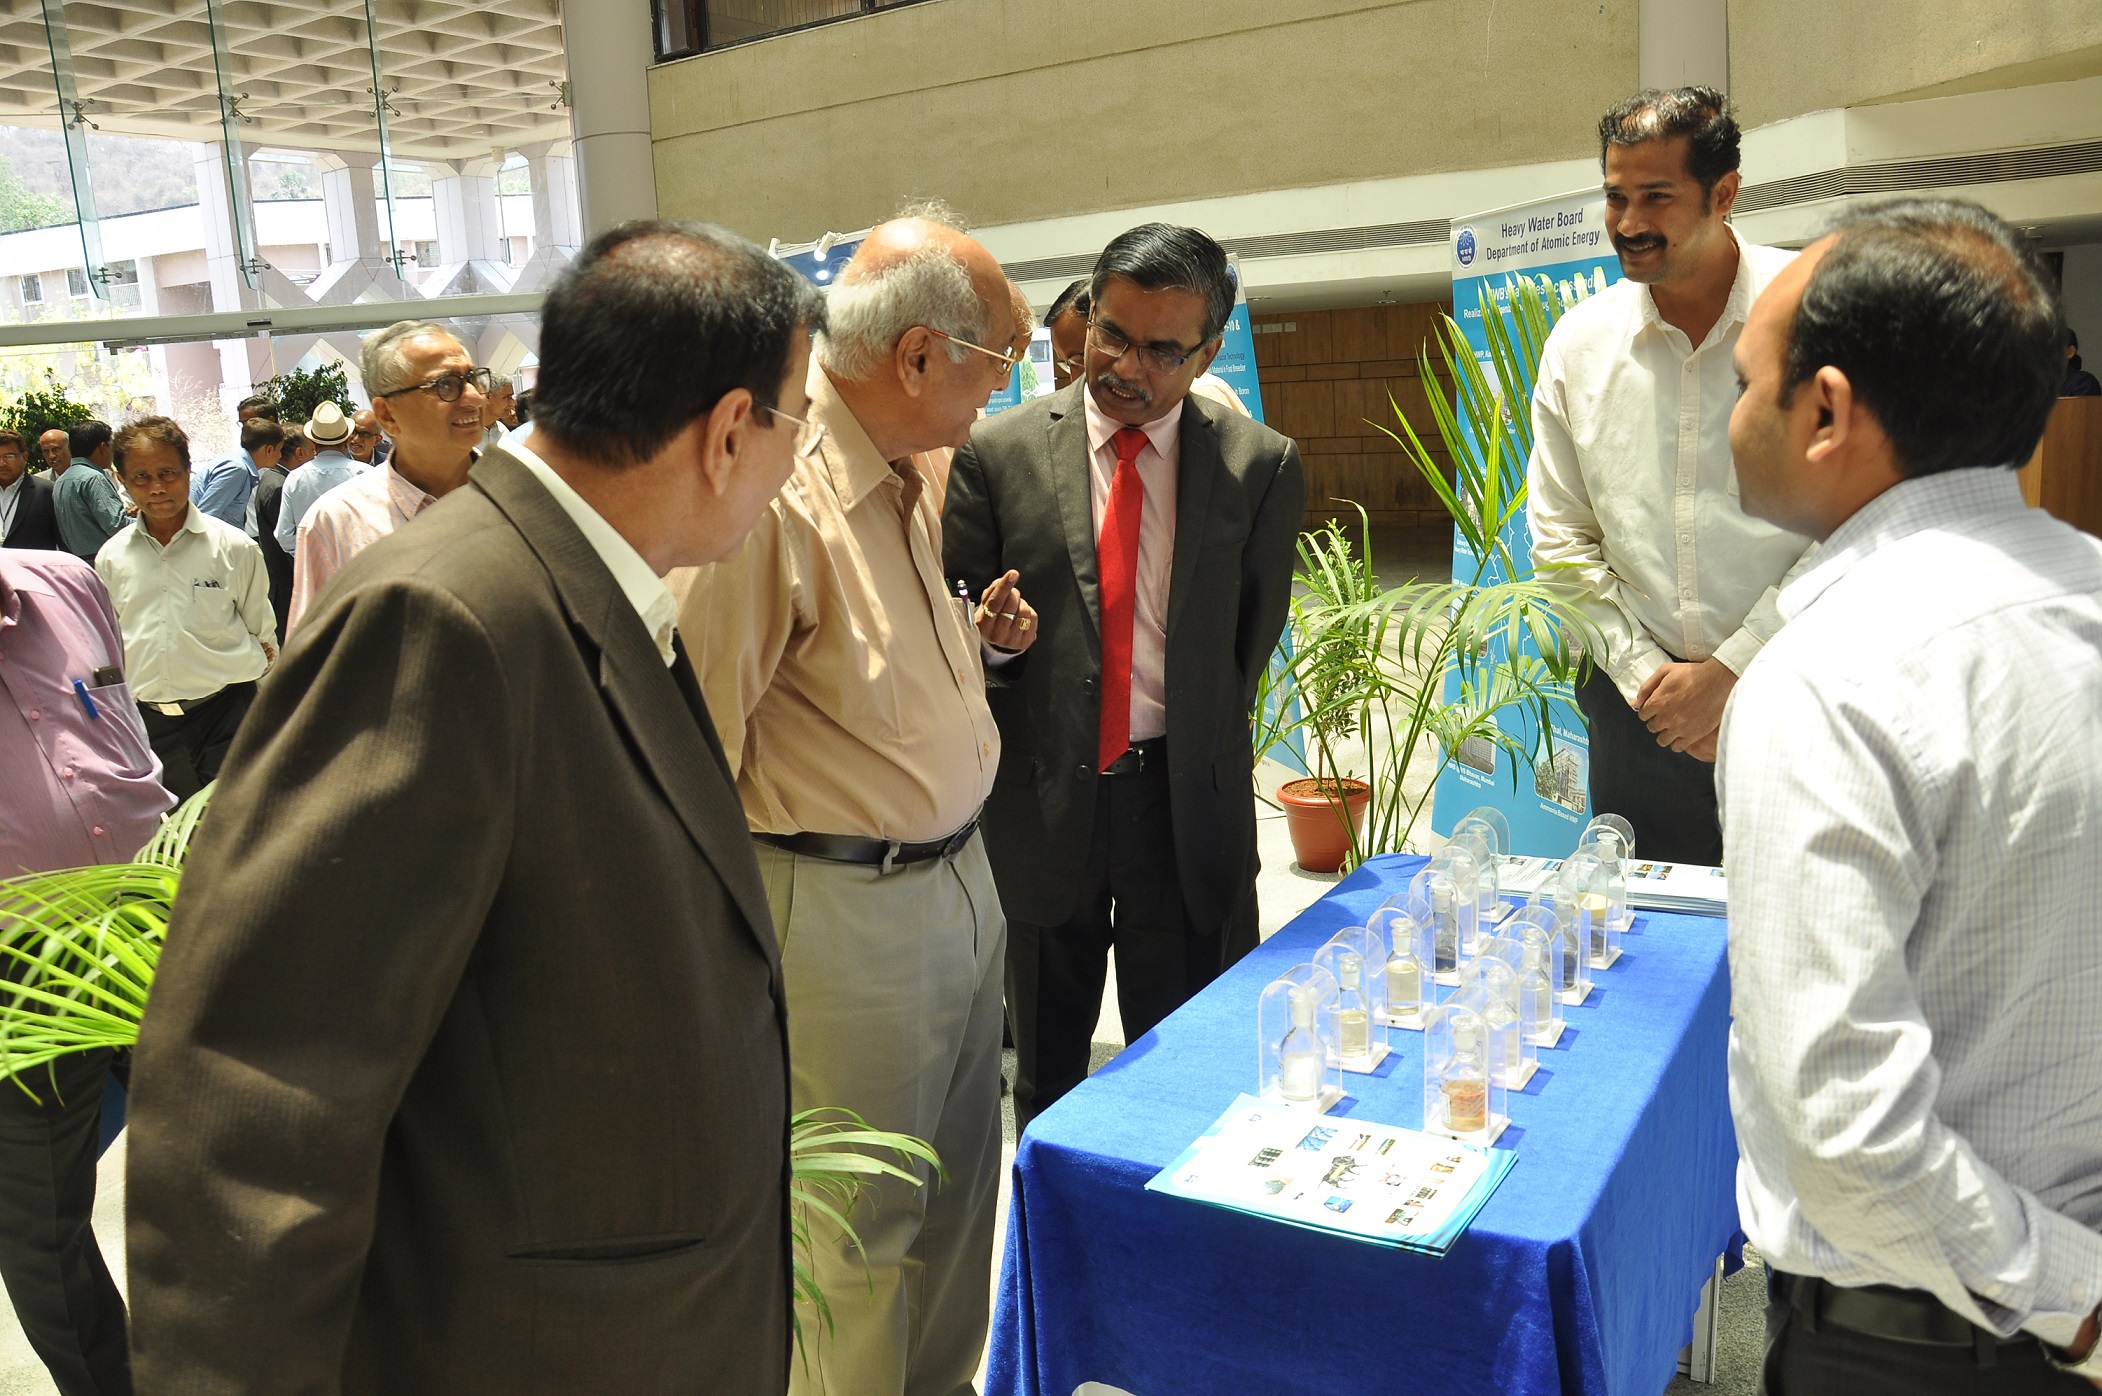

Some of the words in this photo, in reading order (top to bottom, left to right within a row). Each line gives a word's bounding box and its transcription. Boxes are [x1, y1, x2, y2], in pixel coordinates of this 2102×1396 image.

[1501, 220, 1526, 239] Heavy
[1528, 214, 1555, 233] Water
[1557, 208, 1584, 228] Board
[1486, 242, 1529, 262] Department
[1530, 241, 1539, 253] of
[1541, 233, 1570, 251] Atomic
[1572, 229, 1600, 247] Energy
[1540, 802, 1558, 815] Ammonia
